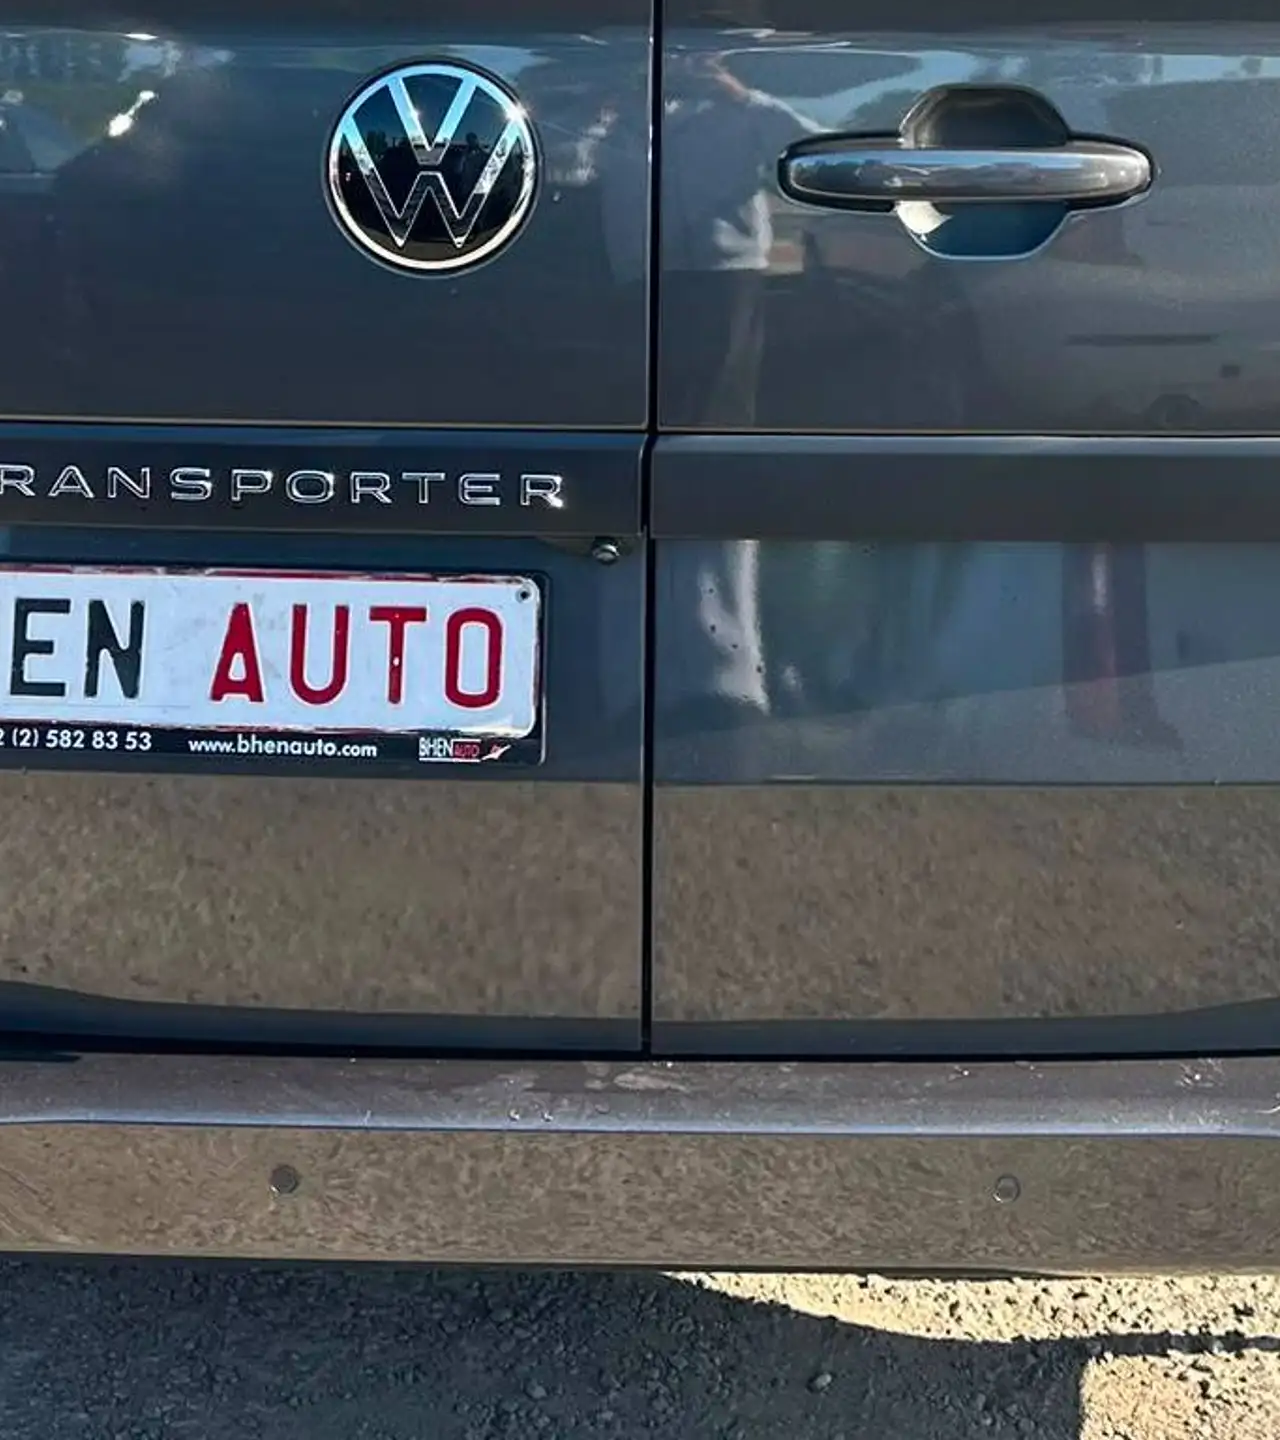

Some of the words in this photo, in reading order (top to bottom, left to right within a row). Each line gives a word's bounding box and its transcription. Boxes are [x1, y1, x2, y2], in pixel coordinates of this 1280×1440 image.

[210, 602, 505, 709] AUTO
[11, 727, 39, 747] (2)
[45, 729, 85, 748] 582
[92, 730, 119, 749] 83
[124, 731, 152, 750] 53
[189, 735, 378, 757] www.bhenauto.com
